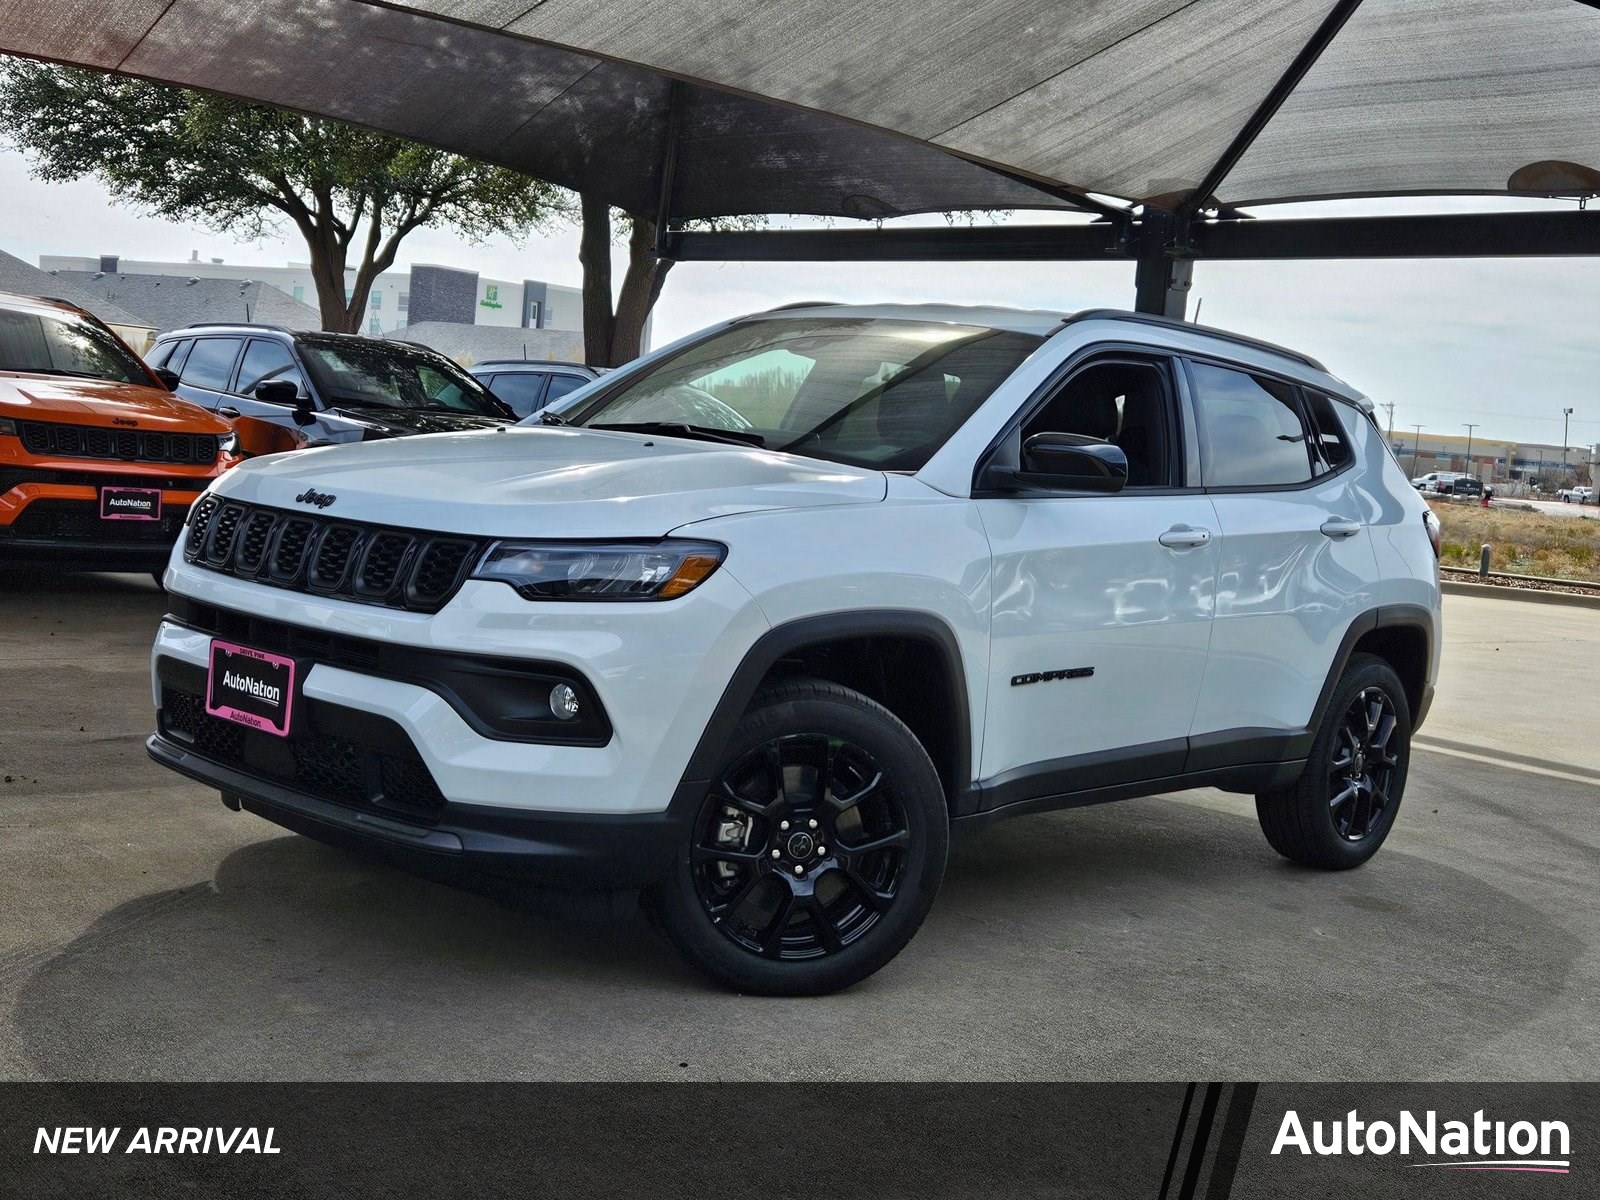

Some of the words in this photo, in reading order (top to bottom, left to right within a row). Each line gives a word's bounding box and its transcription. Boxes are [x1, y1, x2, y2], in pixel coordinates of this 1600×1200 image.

[109, 499, 151, 507] AutoNation
[296, 488, 337, 509] Jeep
[222, 670, 280, 701] AutoNation
[229, 711, 262, 727] AutoNation
